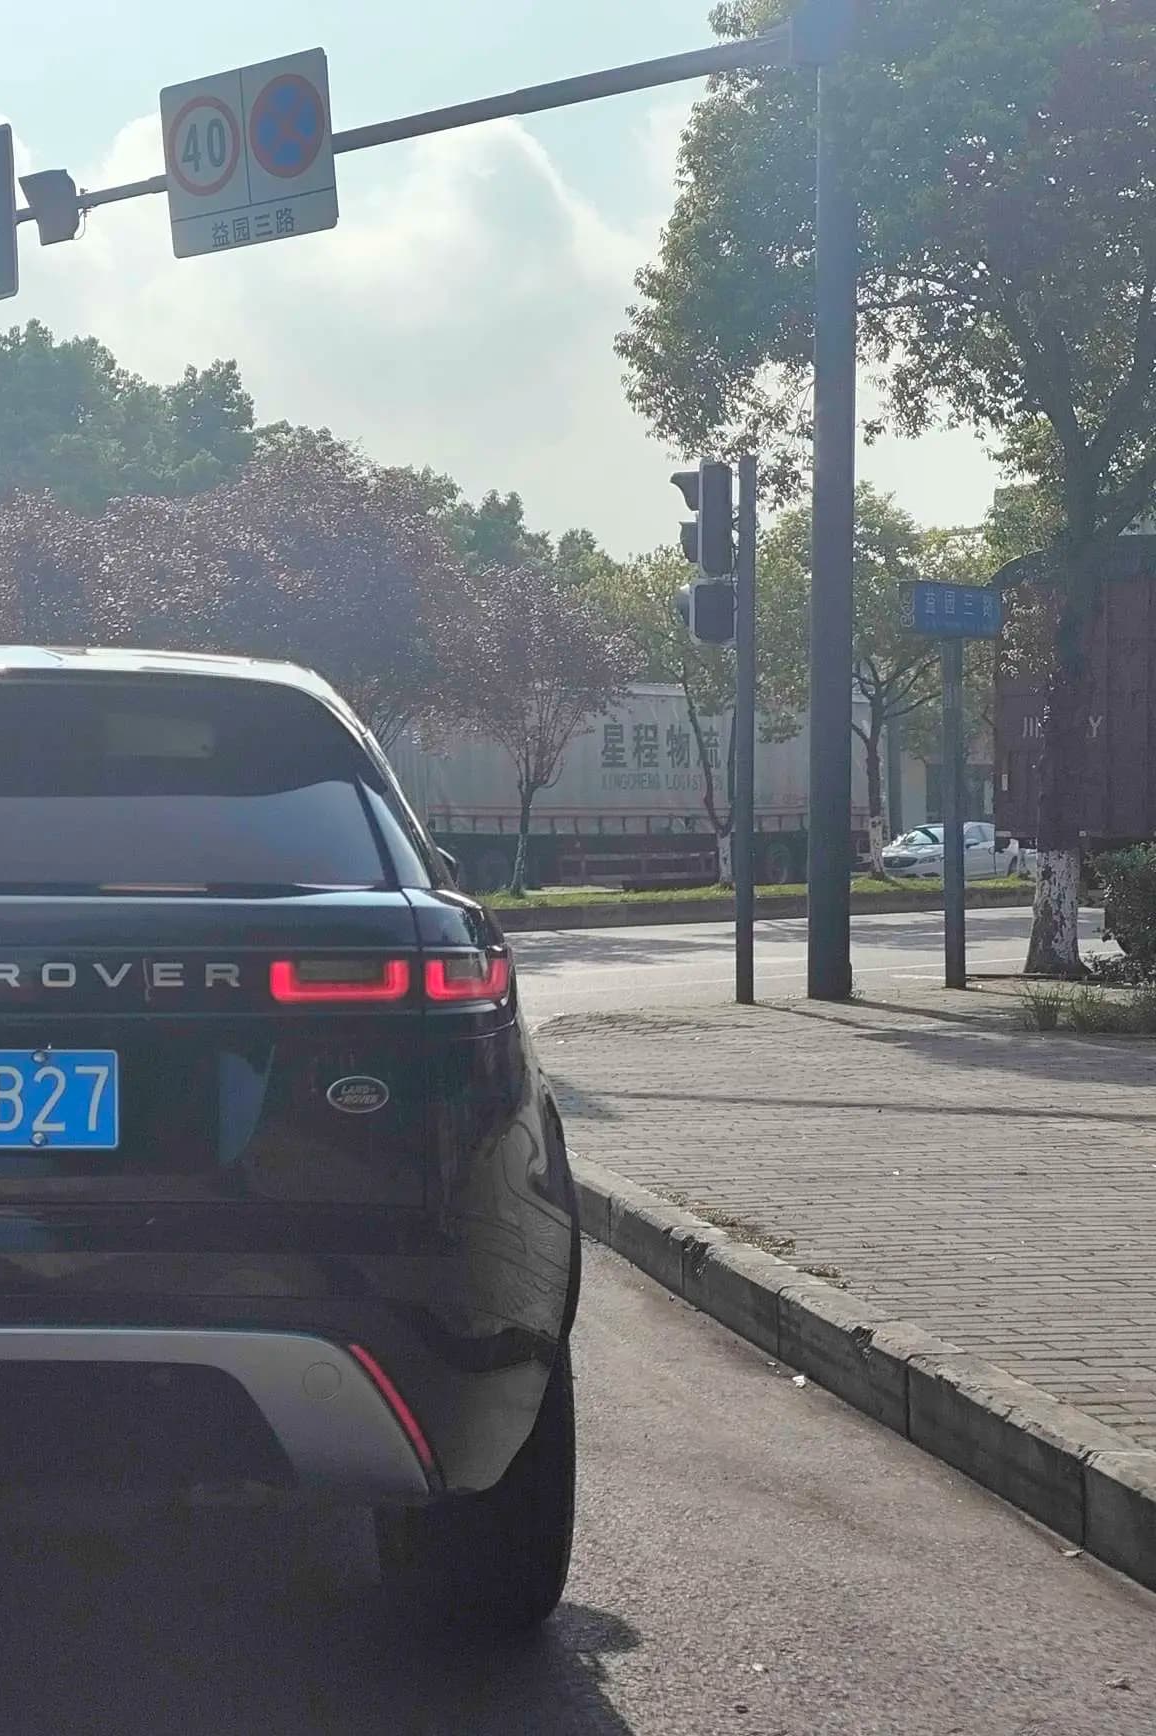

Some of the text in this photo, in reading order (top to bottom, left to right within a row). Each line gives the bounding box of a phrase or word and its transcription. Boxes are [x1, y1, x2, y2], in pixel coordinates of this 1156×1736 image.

[181, 118, 226, 172] 40
[212, 207, 295, 248] 益园三路
[601, 723, 723, 769] 星程物流
